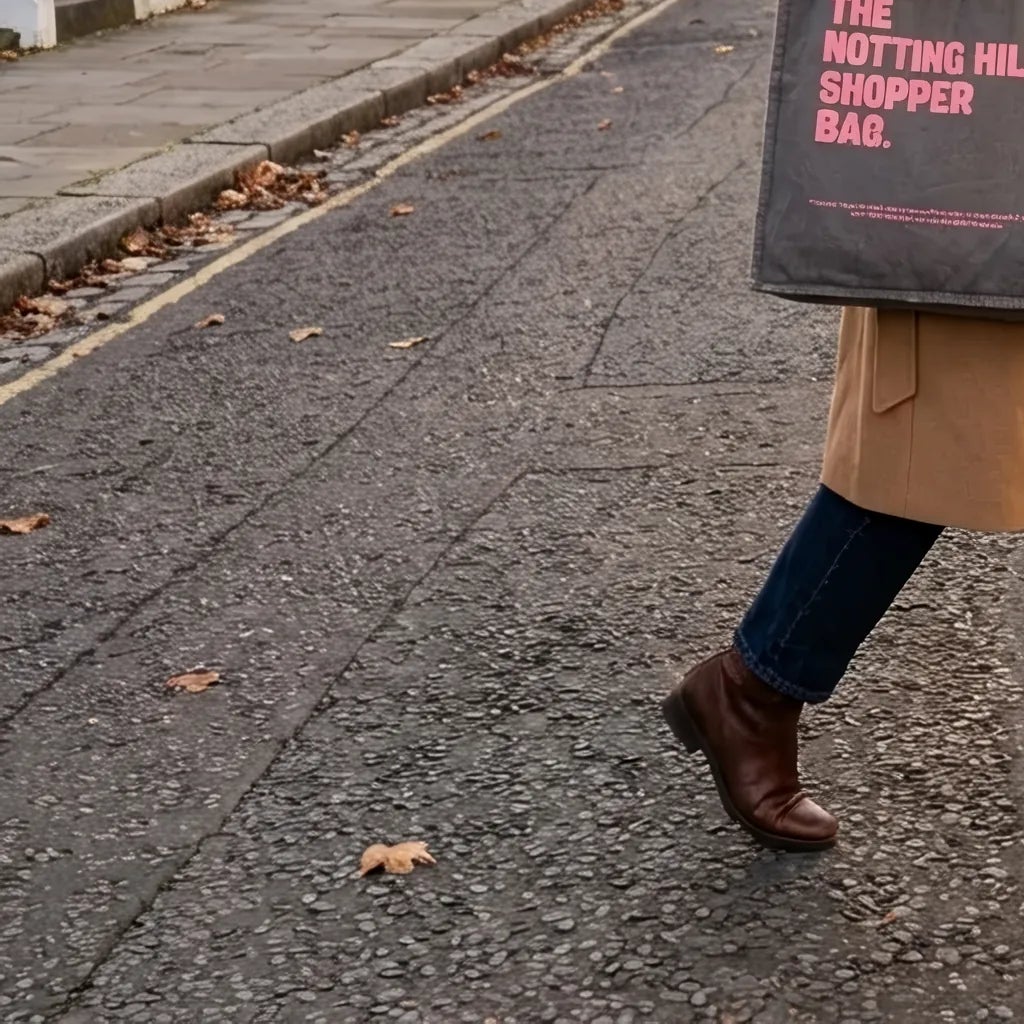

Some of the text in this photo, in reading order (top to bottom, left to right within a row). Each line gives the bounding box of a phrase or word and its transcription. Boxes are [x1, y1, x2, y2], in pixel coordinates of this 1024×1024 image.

[822, 30, 965, 75] NOTTING
[819, 70, 974, 115] SHOPPER
[814, 109, 891, 148] BAG.
